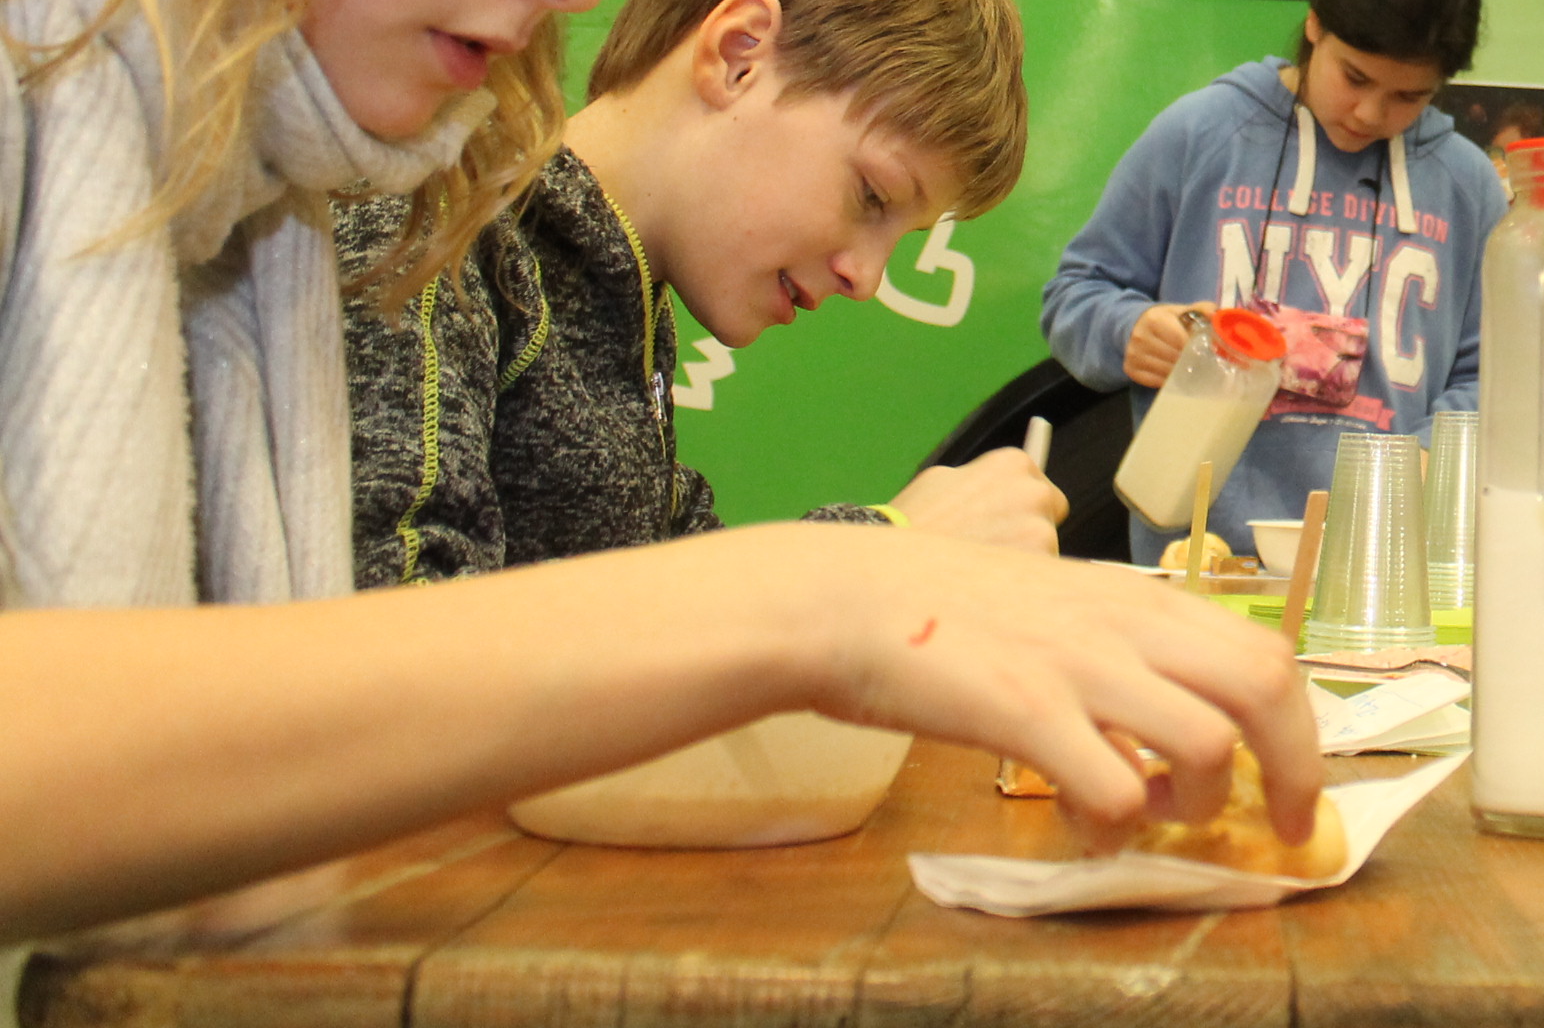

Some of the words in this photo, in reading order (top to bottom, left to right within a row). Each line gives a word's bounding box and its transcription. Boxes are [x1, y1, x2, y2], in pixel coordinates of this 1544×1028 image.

[1218, 184, 1335, 217] COLLGE
[1343, 193, 1449, 245] DIVIION
[1217, 218, 1441, 393] NYC
